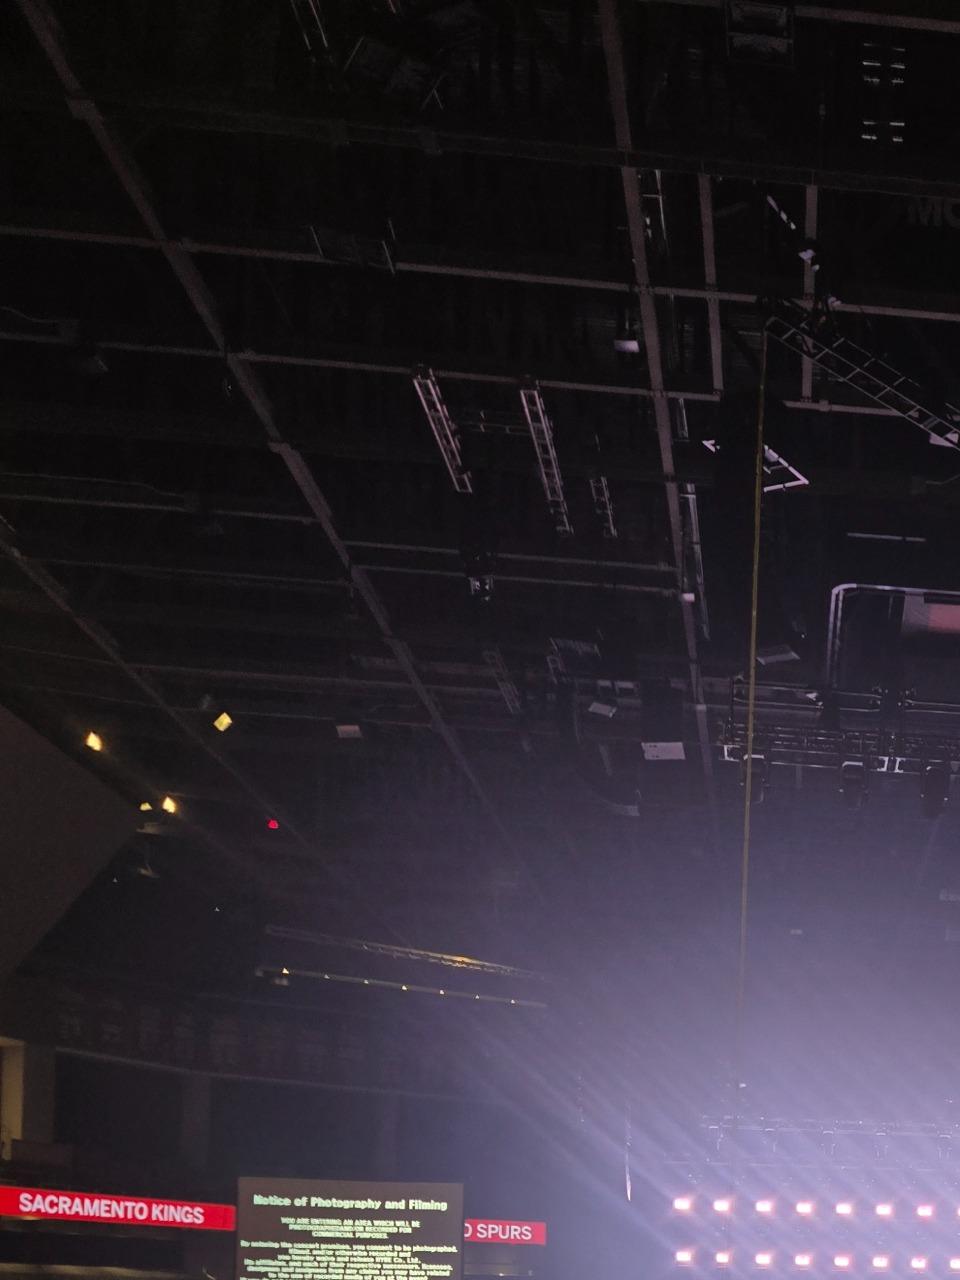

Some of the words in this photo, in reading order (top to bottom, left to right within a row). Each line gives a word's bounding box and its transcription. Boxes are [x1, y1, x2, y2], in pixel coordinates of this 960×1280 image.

[19, 1192, 149, 1220] SACRAMENTO
[151, 1203, 205, 1224] KINGS
[254, 1194, 291, 1205] Notice
[294, 1196, 308, 1206] of
[310, 1197, 381, 1209] Photography
[385, 1199, 405, 1209] and
[409, 1199, 447, 1211] Filming
[476, 1224, 532, 1240] SPURS
